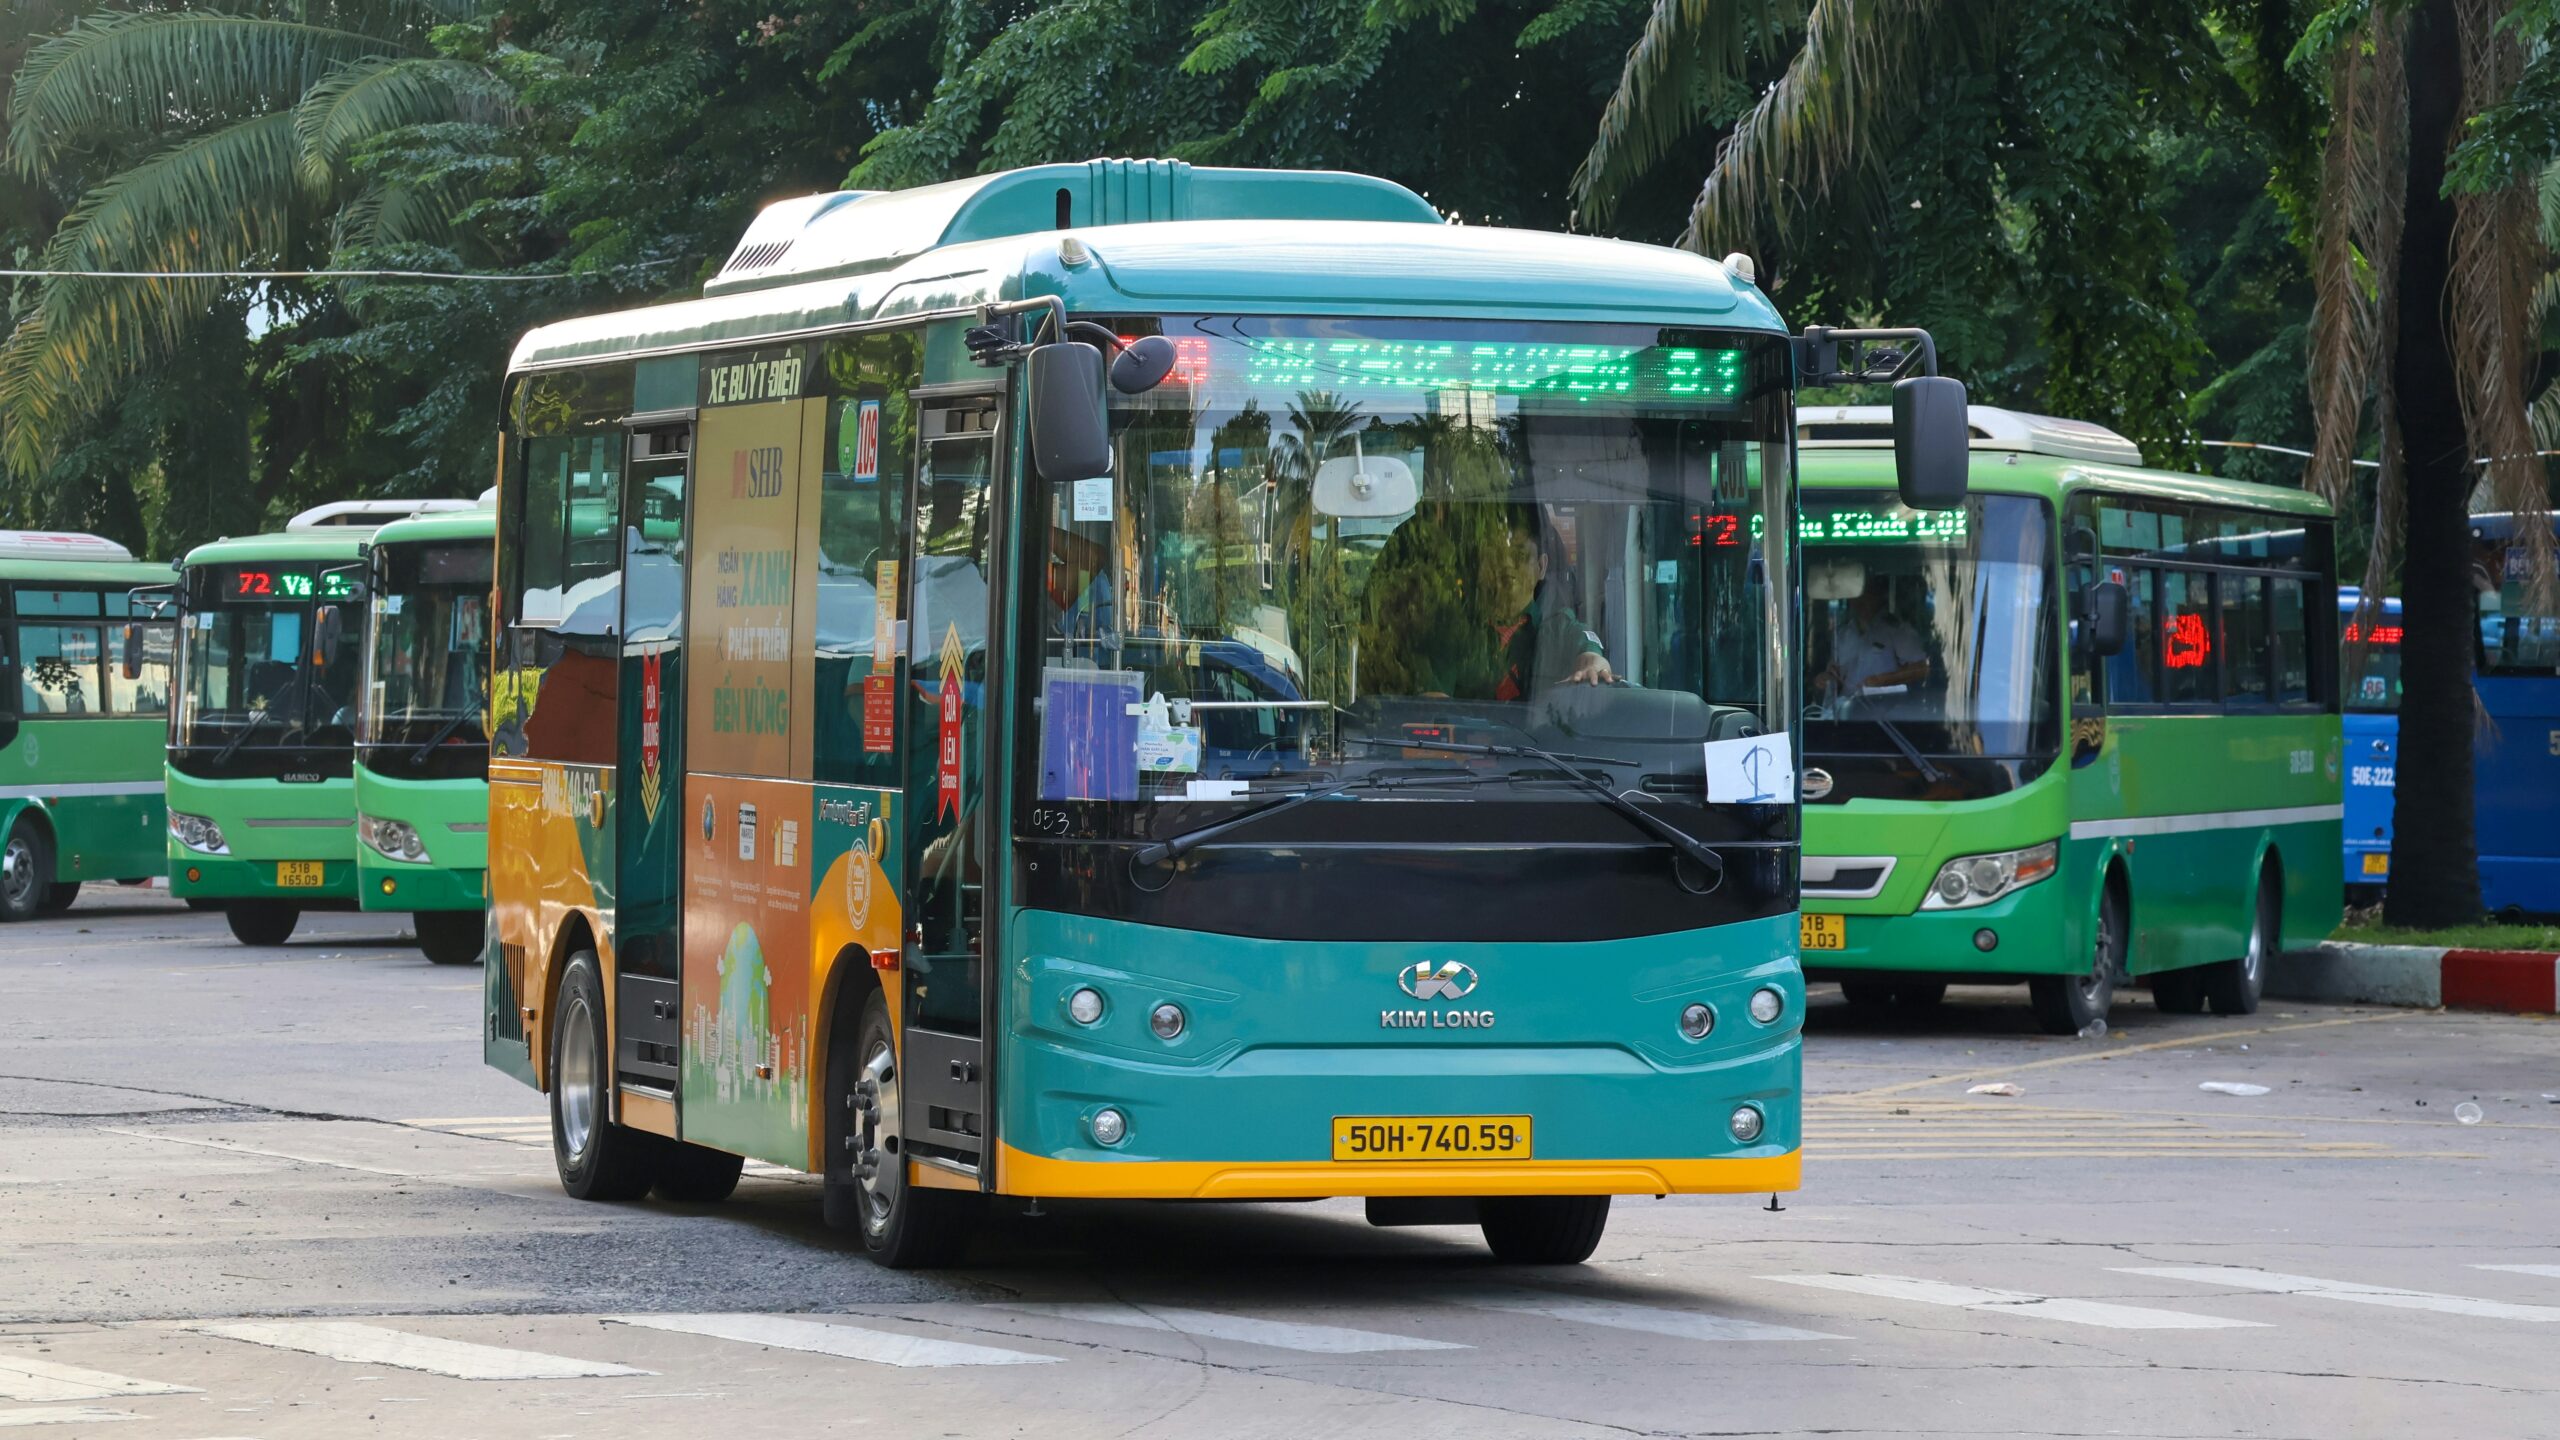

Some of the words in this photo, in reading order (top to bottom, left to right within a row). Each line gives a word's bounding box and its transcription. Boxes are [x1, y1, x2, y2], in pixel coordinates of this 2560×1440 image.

[708, 366, 728, 404] XE
[728, 352, 768, 401] BUÝT
[768, 348, 801, 405] ĐIỆN
[857, 409, 878, 474] 109
[749, 447, 783, 497] SHB
[1832, 512, 1908, 537] Kênh
[717, 546, 739, 574] NGÂN
[239, 573, 270, 594] 72
[739, 551, 791, 607] XANH
[716, 580, 737, 608] HÀNG
[727, 617, 755, 662] PHÁT
[755, 611, 789, 662] TRIỂN
[713, 668, 742, 734] BỀN
[944, 730, 956, 765] LÊN
[283, 773, 320, 782] SAMCO
[1033, 808, 1070, 835] 053
[283, 874, 318, 885] 165.09
[290, 863, 310, 873] 51B
[1800, 932, 1837, 948] 3.03
[1381, 1010, 1427, 1029] KIM
[1432, 1010, 1496, 1029] LONG
[1350, 1124, 1515, 1153] 50H-740.59
